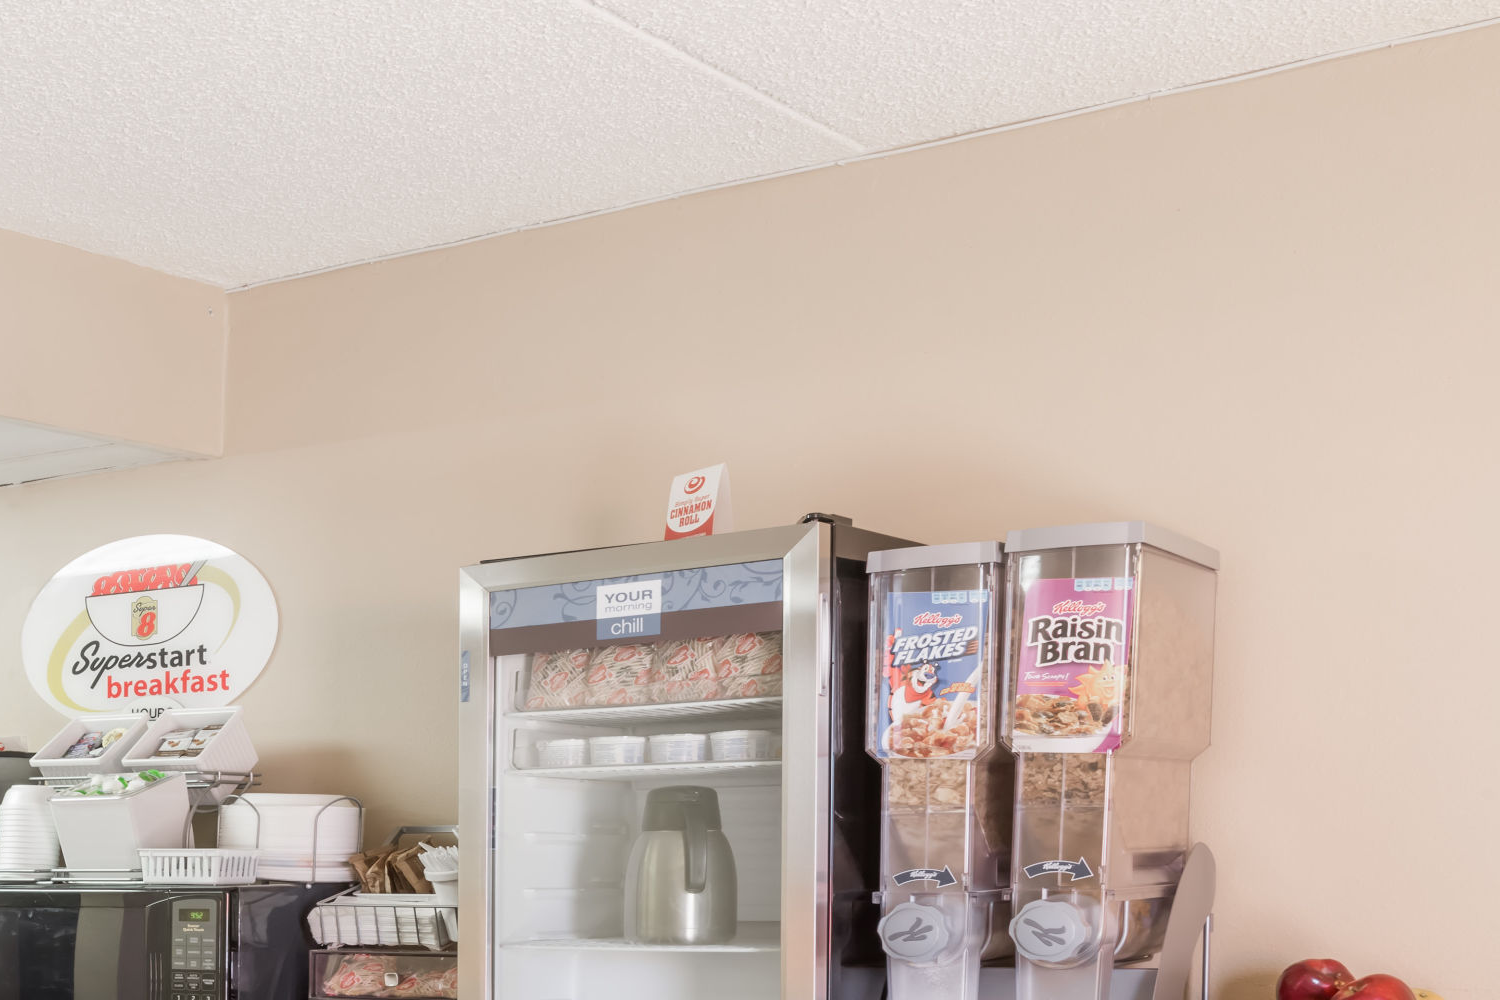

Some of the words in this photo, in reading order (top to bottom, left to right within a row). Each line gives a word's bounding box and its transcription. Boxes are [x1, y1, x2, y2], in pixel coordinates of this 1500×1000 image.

[670, 499, 713, 519] CINNAMON
[679, 513, 700, 527] ROLL
[605, 589, 653, 604] YOUR
[133, 602, 157, 617] Super
[605, 602, 653, 613] morning
[1053, 600, 1106, 616] Kellogg's
[137, 611, 157, 638] 8
[611, 617, 644, 635] chill
[913, 612, 963, 628] Kellogg's
[892, 627, 978, 653] FROSTED
[1030, 617, 1123, 644] Raisin
[892, 641, 967, 667] FLAKES
[1039, 640, 1111, 665] Bran
[71, 640, 208, 690] Superstart
[107, 669, 230, 699] breakfast
